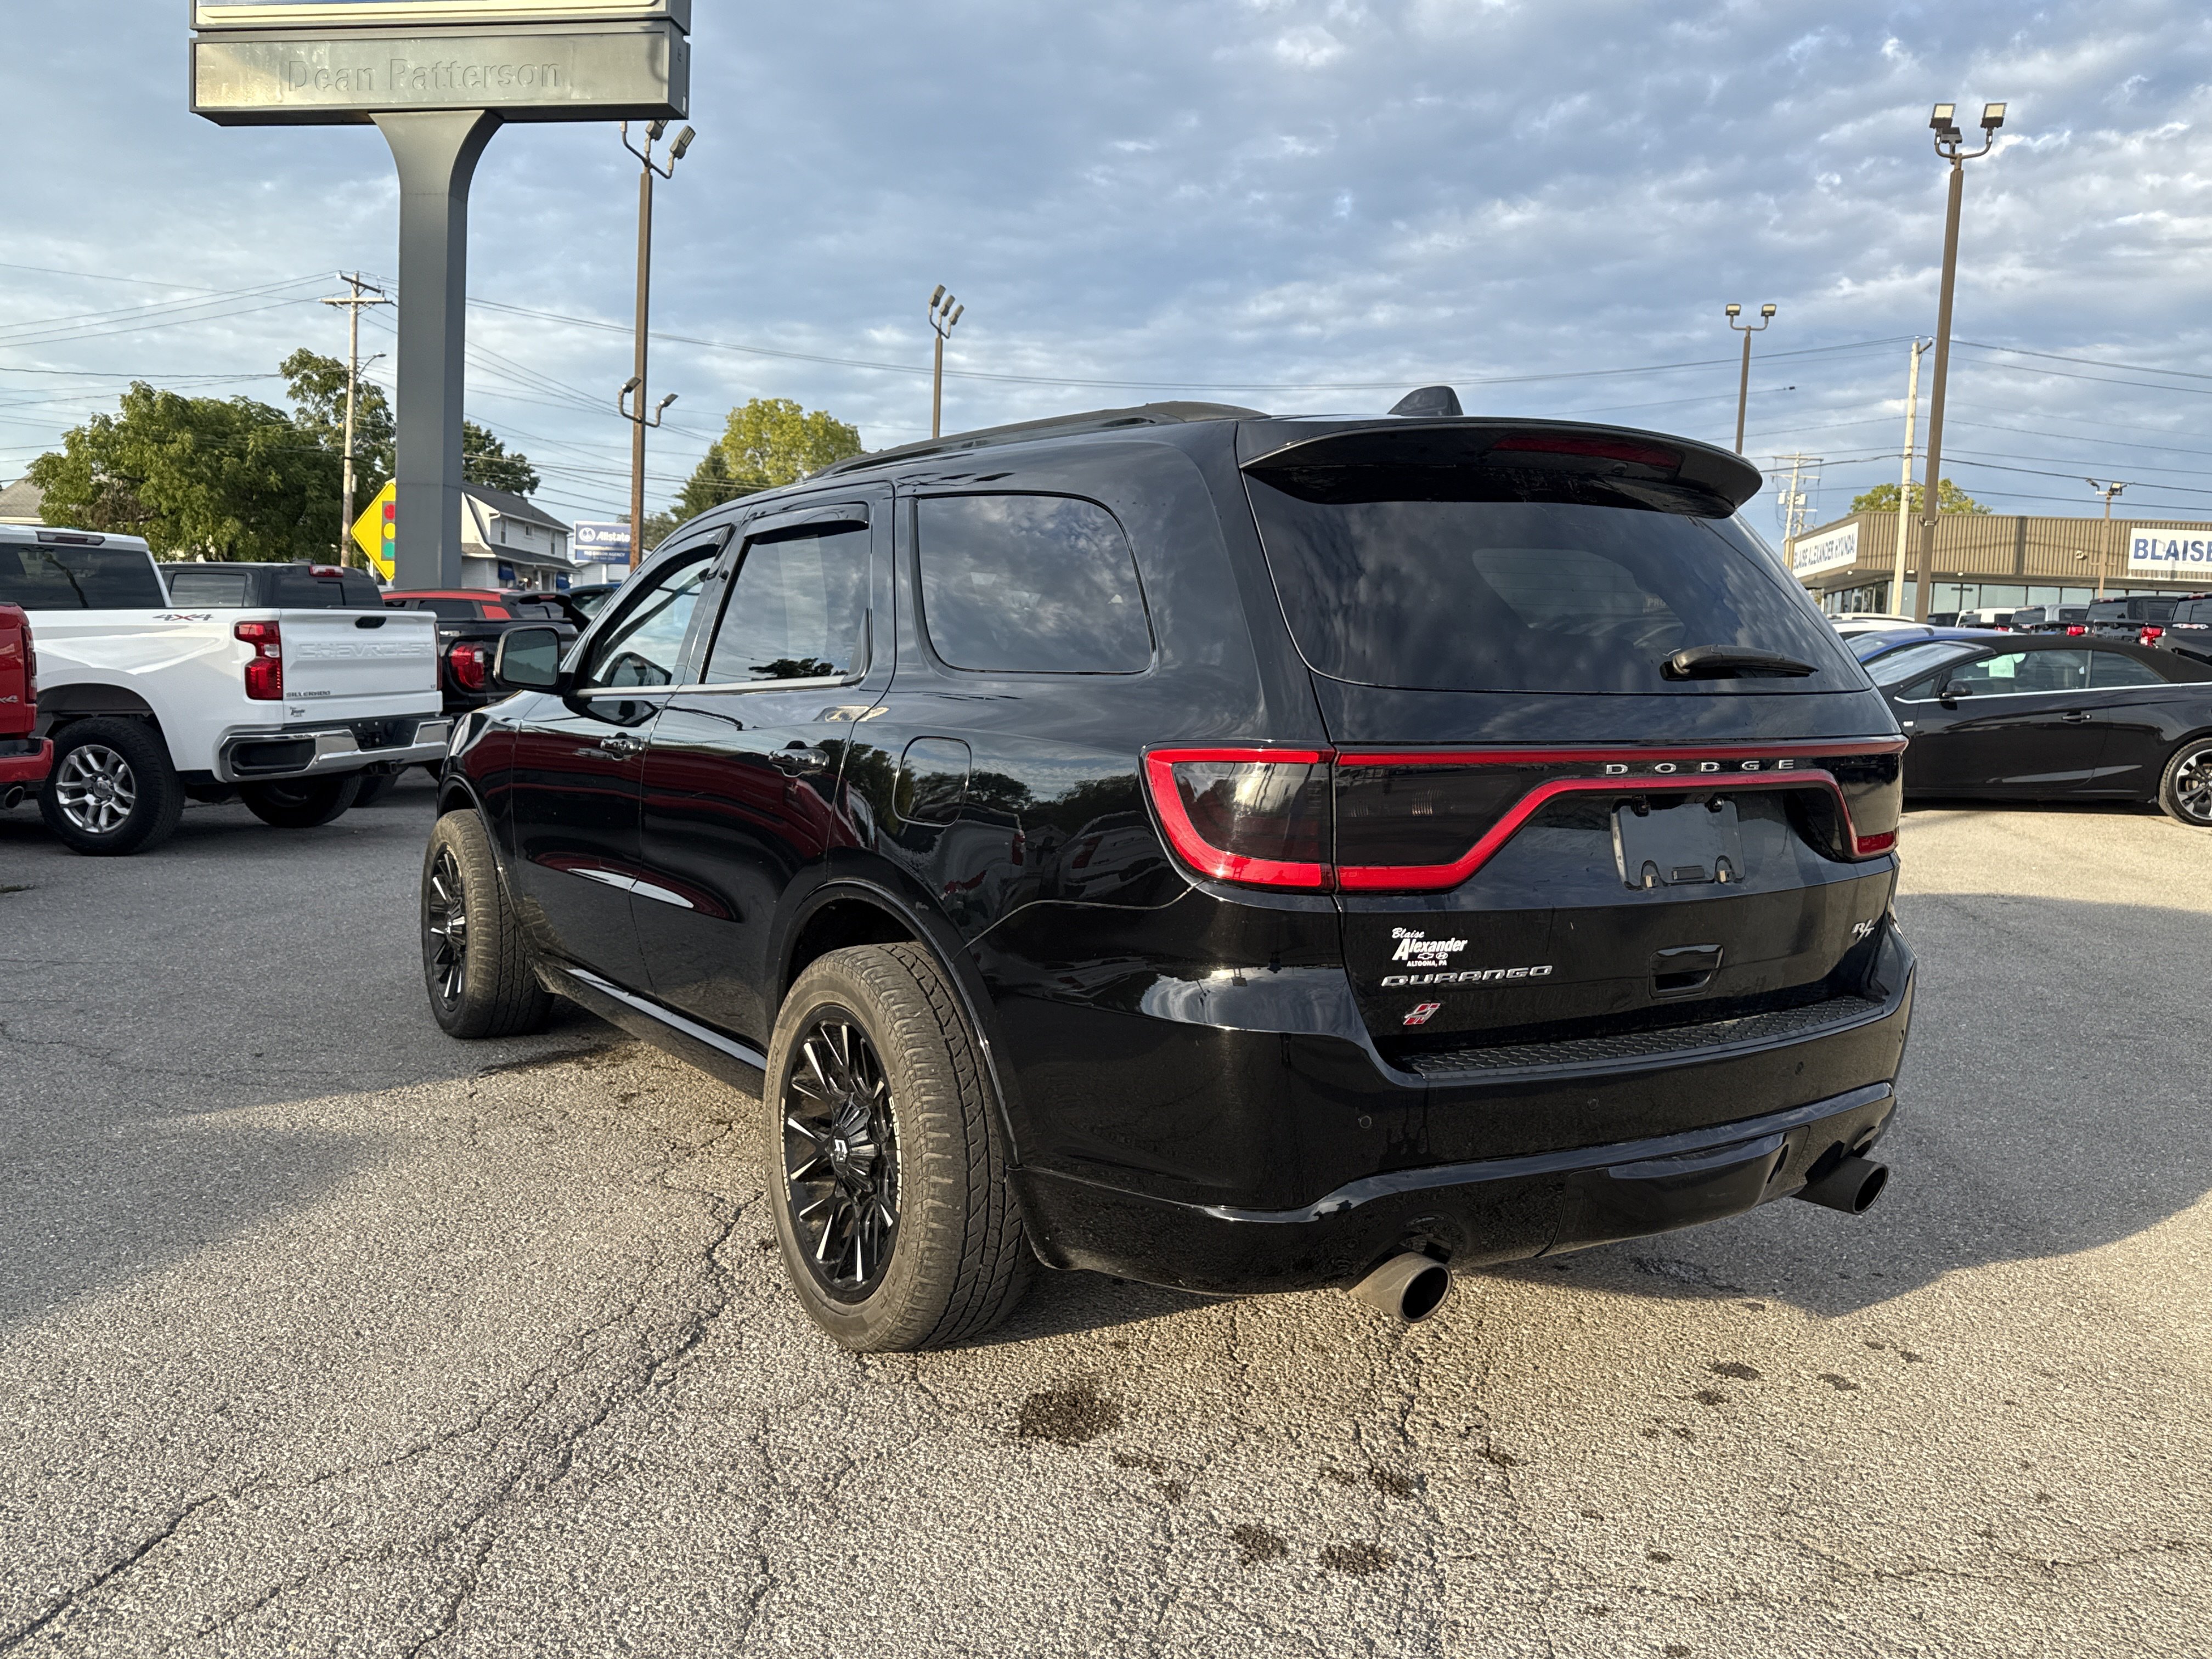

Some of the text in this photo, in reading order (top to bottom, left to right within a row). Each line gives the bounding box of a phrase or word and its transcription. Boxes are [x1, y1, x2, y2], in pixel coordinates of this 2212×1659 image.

[288, 58, 560, 92] Dean Patterson
[596, 531, 630, 543] Allstate
[297, 642, 432, 658] CHEVROLET
[1605, 759, 1795, 775] DODGE
[1392, 927, 1425, 939] Blaise
[1391, 937, 1469, 961] Alexander
[1380, 964, 1553, 988] DURANGO
[780, 1097, 792, 1202] DROPSTARS
[889, 1096, 903, 1214] DROPSTARS
